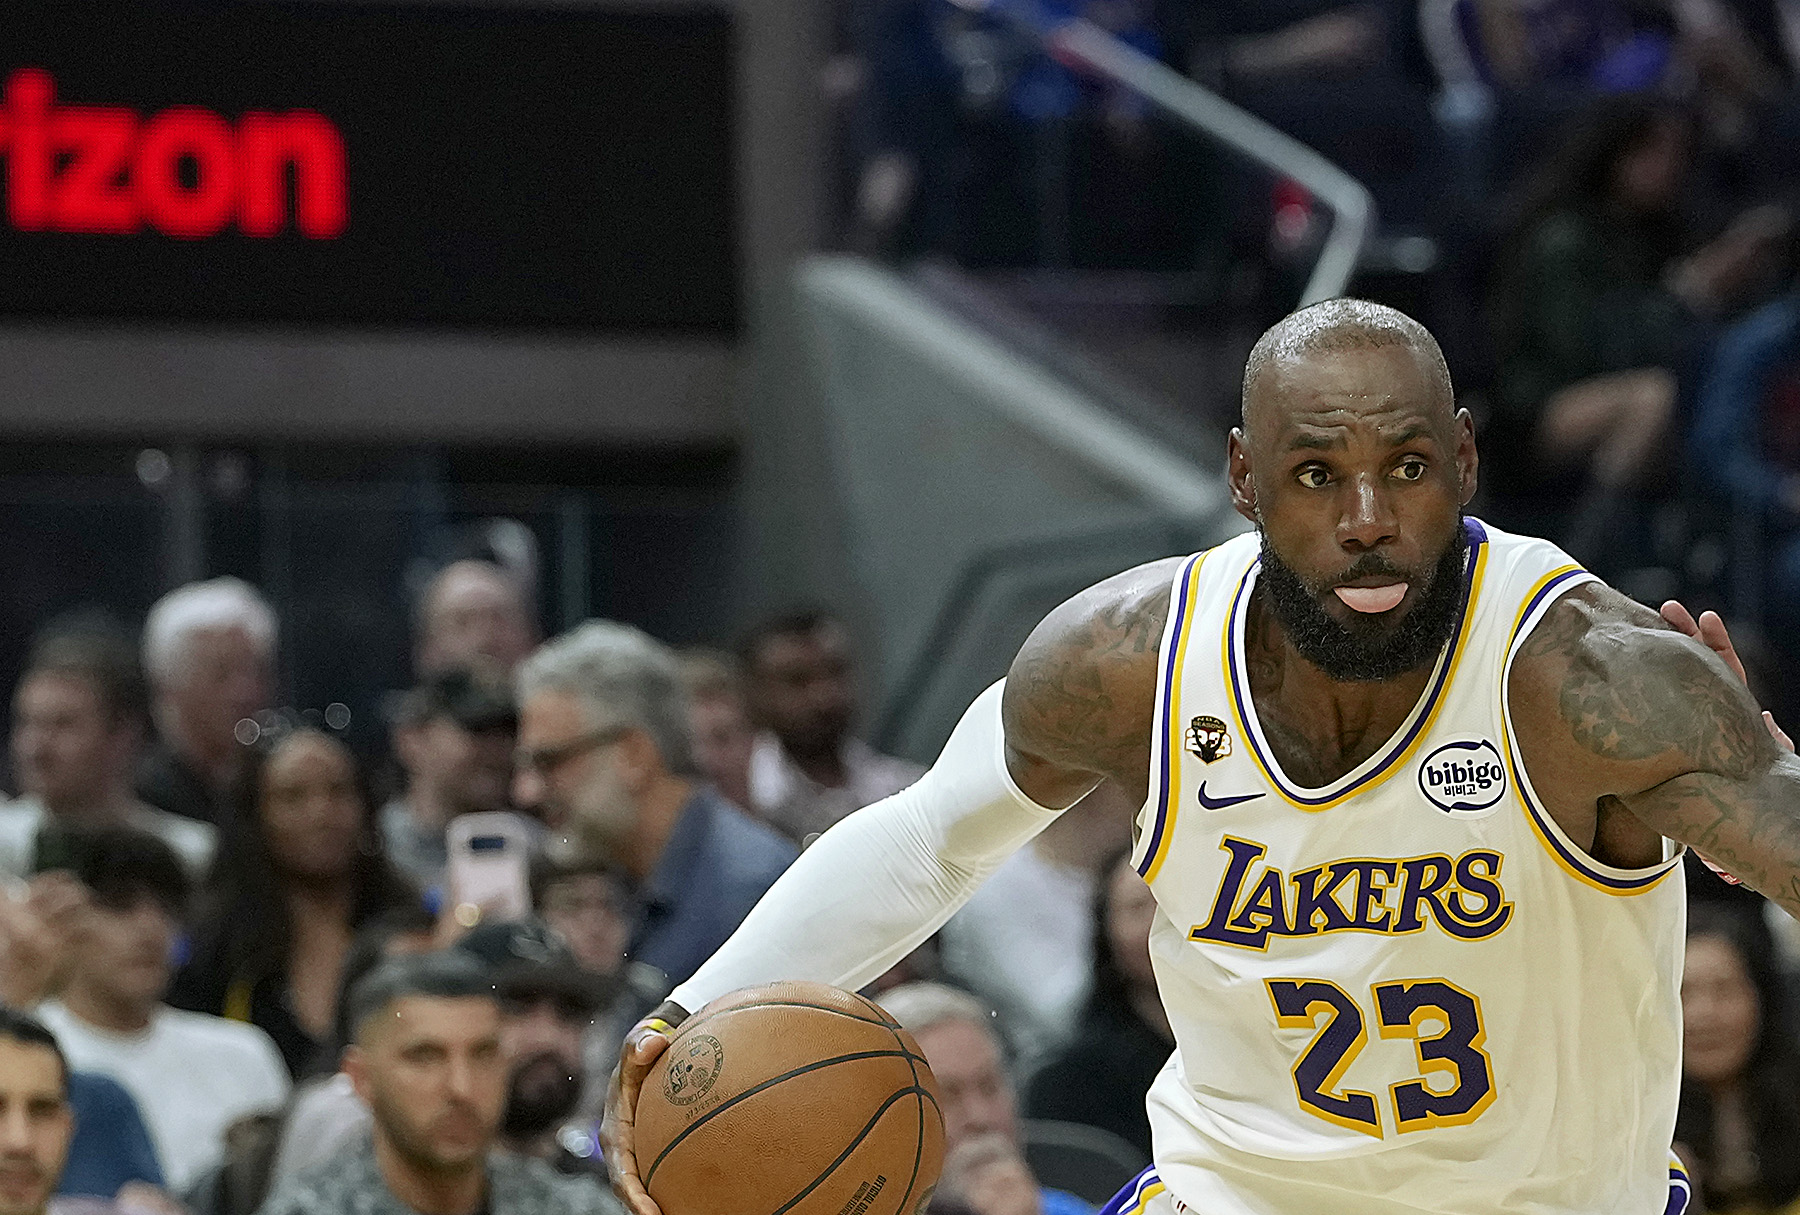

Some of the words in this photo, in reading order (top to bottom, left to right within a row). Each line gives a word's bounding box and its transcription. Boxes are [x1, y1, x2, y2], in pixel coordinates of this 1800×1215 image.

[0, 68, 350, 240] izon
[1426, 759, 1502, 790] bibigo
[1444, 784, 1477, 797] 비비고
[1189, 834, 1515, 952] LAKERS
[1264, 976, 1497, 1140] 23
